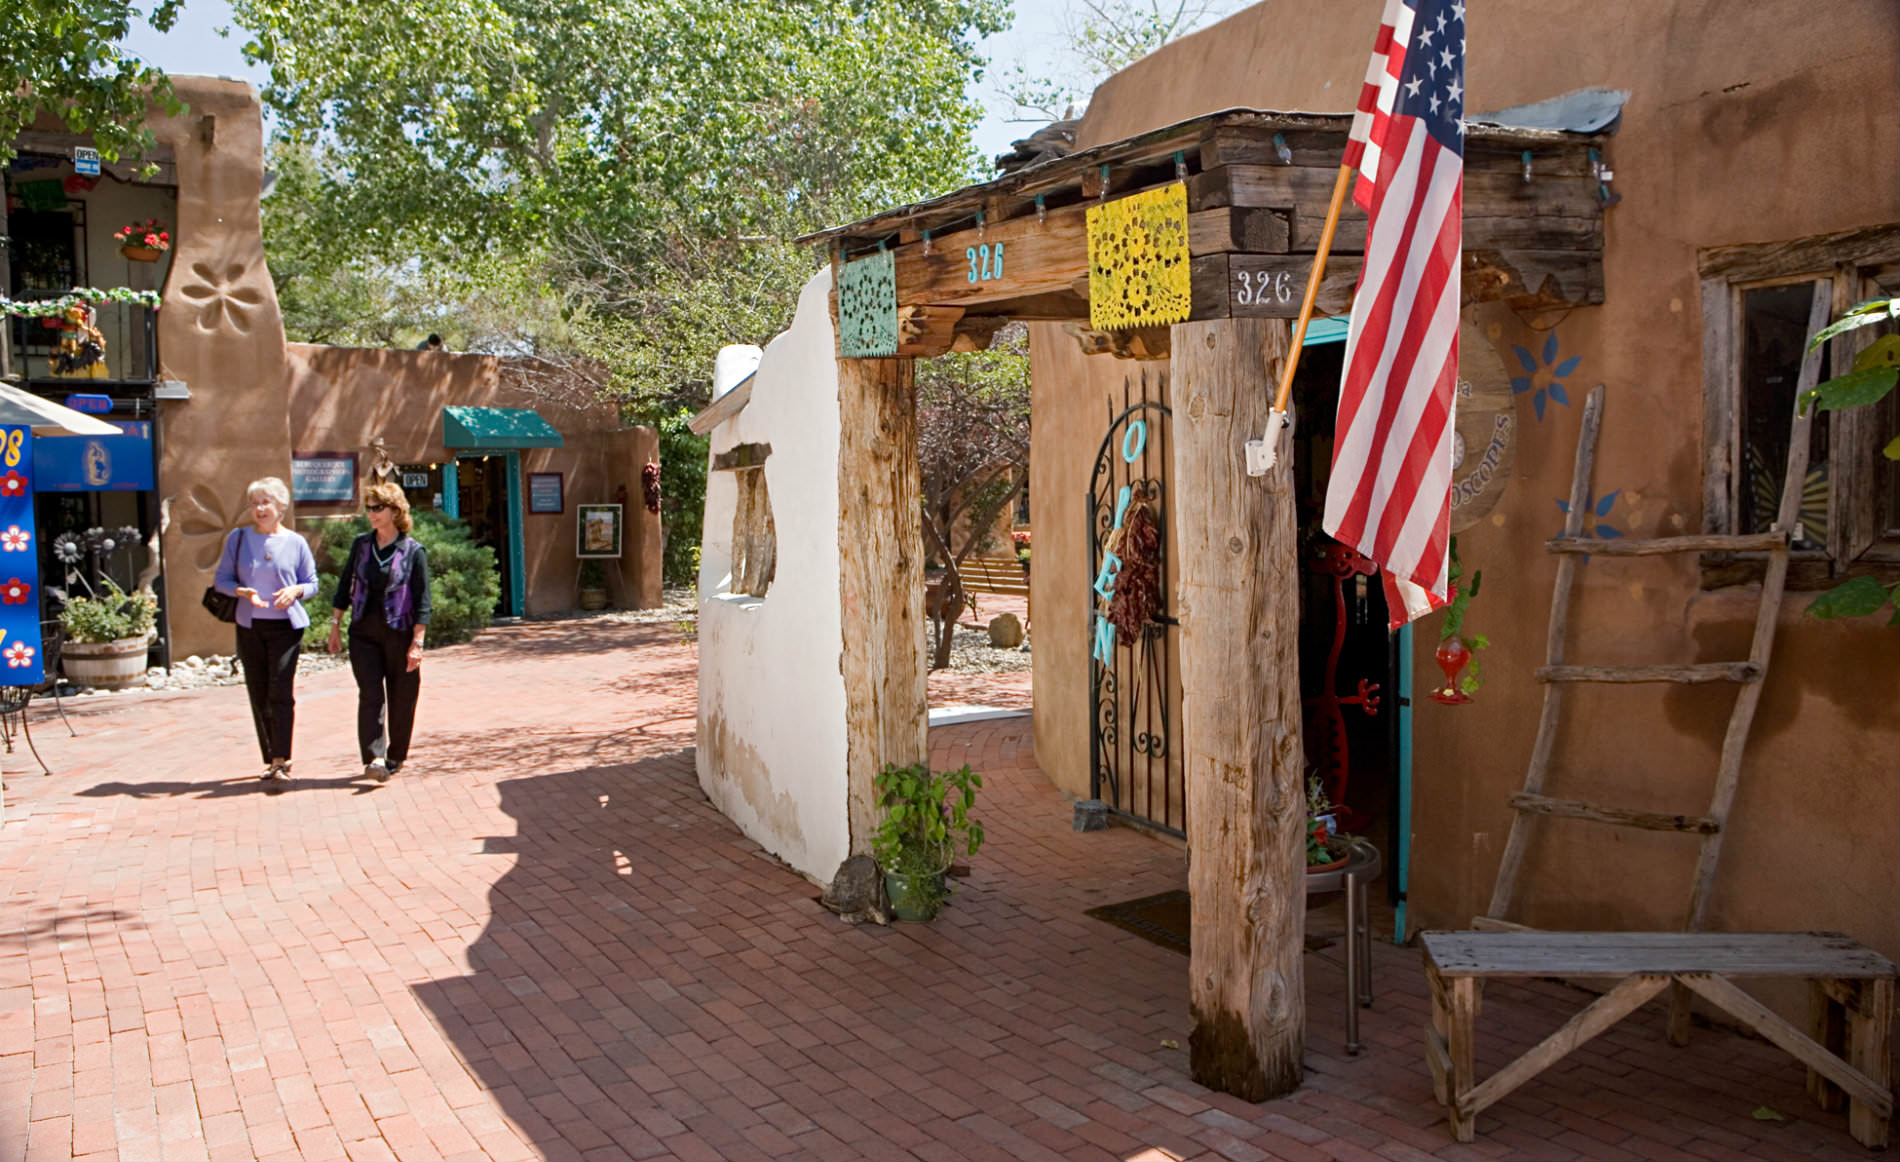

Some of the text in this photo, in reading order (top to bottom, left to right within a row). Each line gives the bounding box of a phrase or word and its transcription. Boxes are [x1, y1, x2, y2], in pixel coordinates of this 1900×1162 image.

[77, 149, 99, 160] OPEN
[966, 243, 1004, 283] 326
[1238, 271, 1291, 304] 326
[69, 398, 107, 410] OPEN
[406, 474, 426, 486] OPEN
